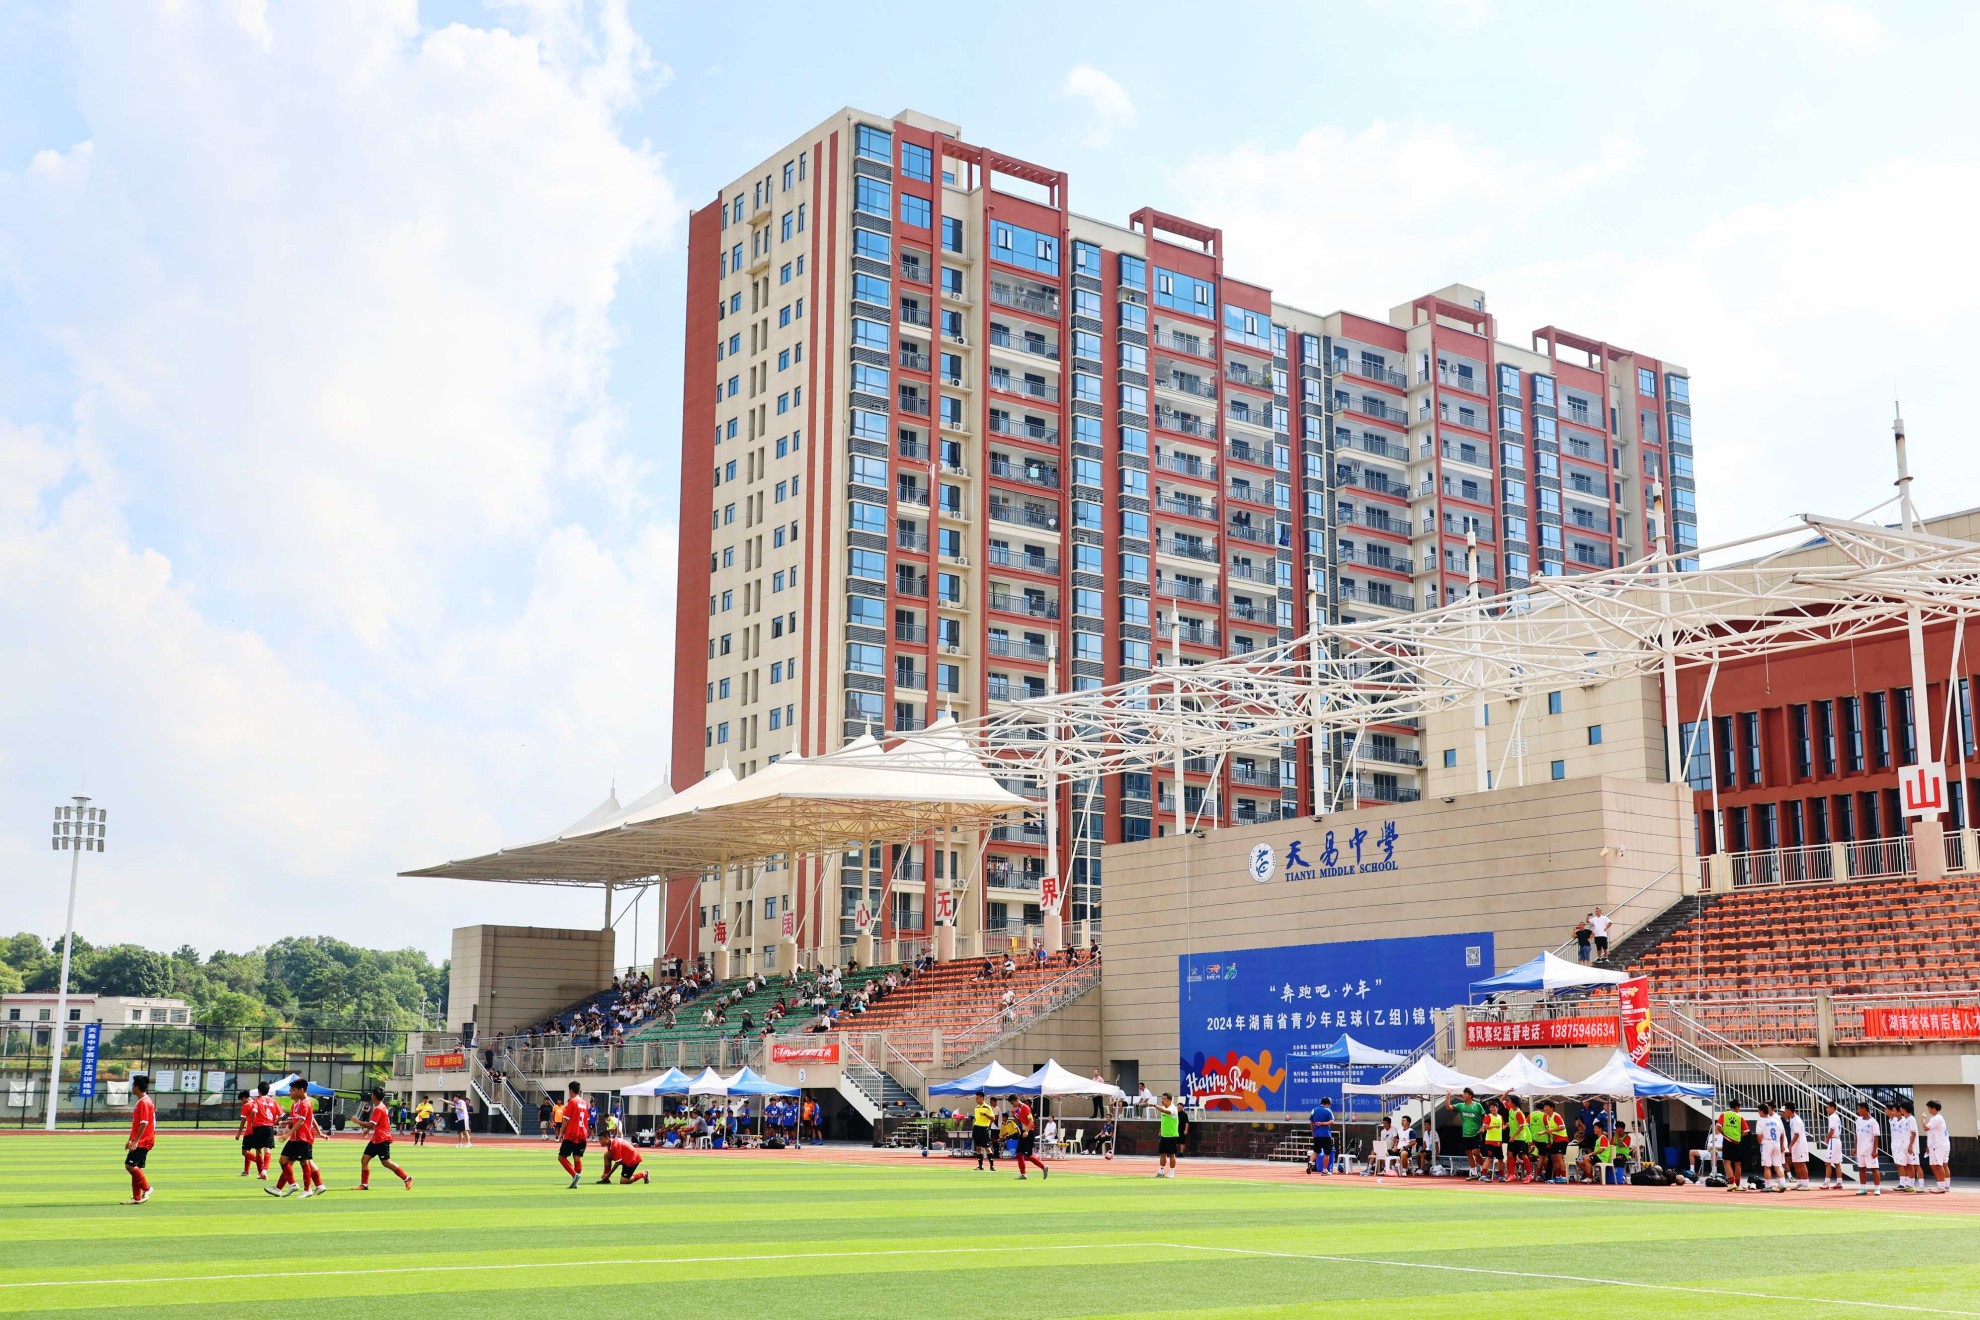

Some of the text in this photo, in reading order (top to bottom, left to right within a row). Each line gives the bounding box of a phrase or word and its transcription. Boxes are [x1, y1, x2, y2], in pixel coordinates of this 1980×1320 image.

[1906, 769, 1941, 809] 山
[1285, 820, 1399, 870] 天易中學
[1285, 860, 1398, 882] TIANYI MIDDLE SCHOOL
[937, 891, 952, 918] 无
[1041, 878, 1058, 908] 界
[782, 912, 794, 937] 阔
[856, 903, 871, 927] 心
[713, 921, 727, 944] 海
[1550, 1022, 1615, 1038] 13875946634
[1186, 1066, 1258, 1098] Happy Run
